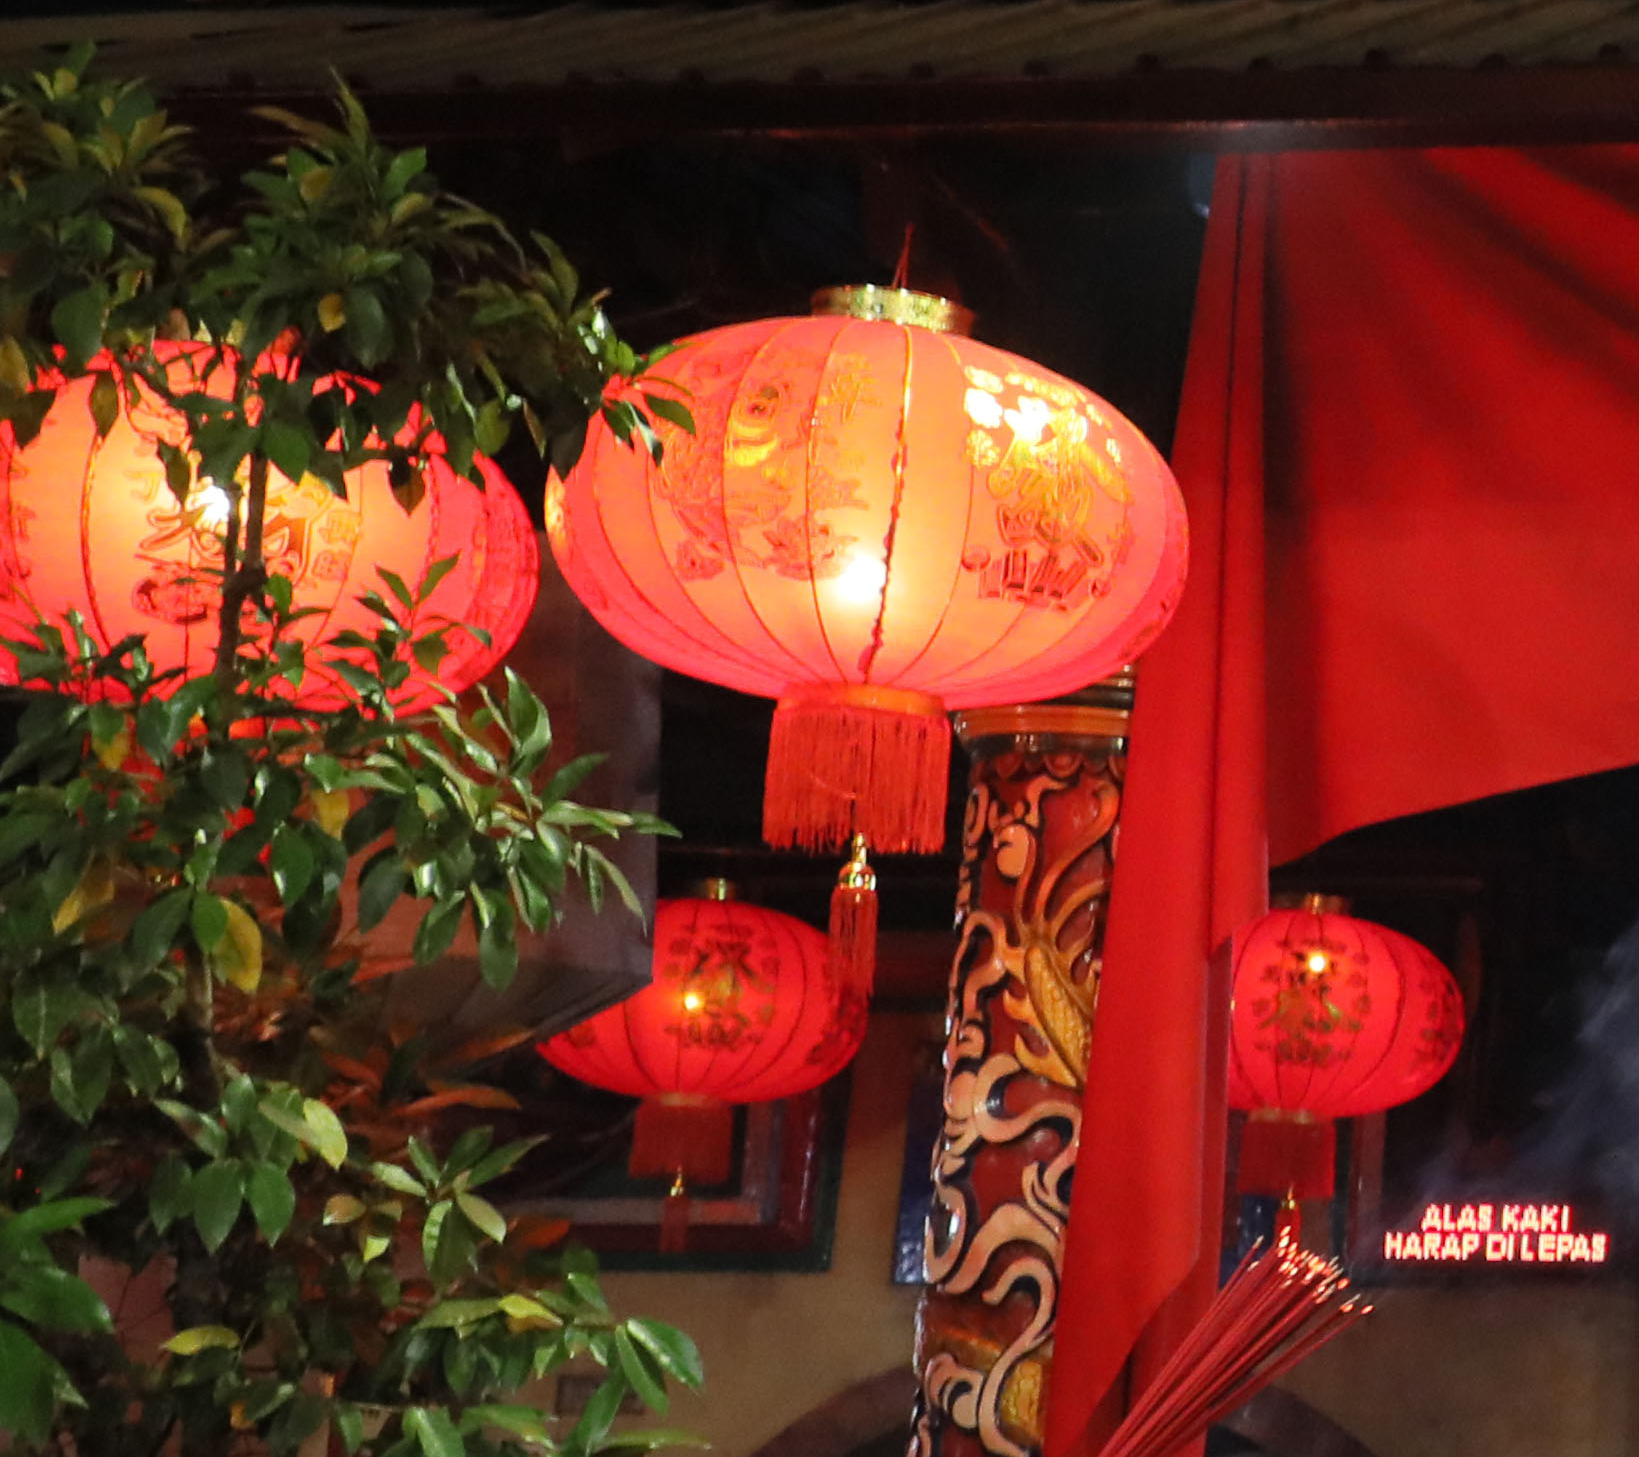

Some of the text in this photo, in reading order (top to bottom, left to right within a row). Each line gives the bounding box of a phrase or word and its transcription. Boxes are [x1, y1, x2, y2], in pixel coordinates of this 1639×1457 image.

[1420, 1204, 1570, 1232] ALAS KAKI
[1384, 1231, 1608, 1263] HARAP DI LEPAS
